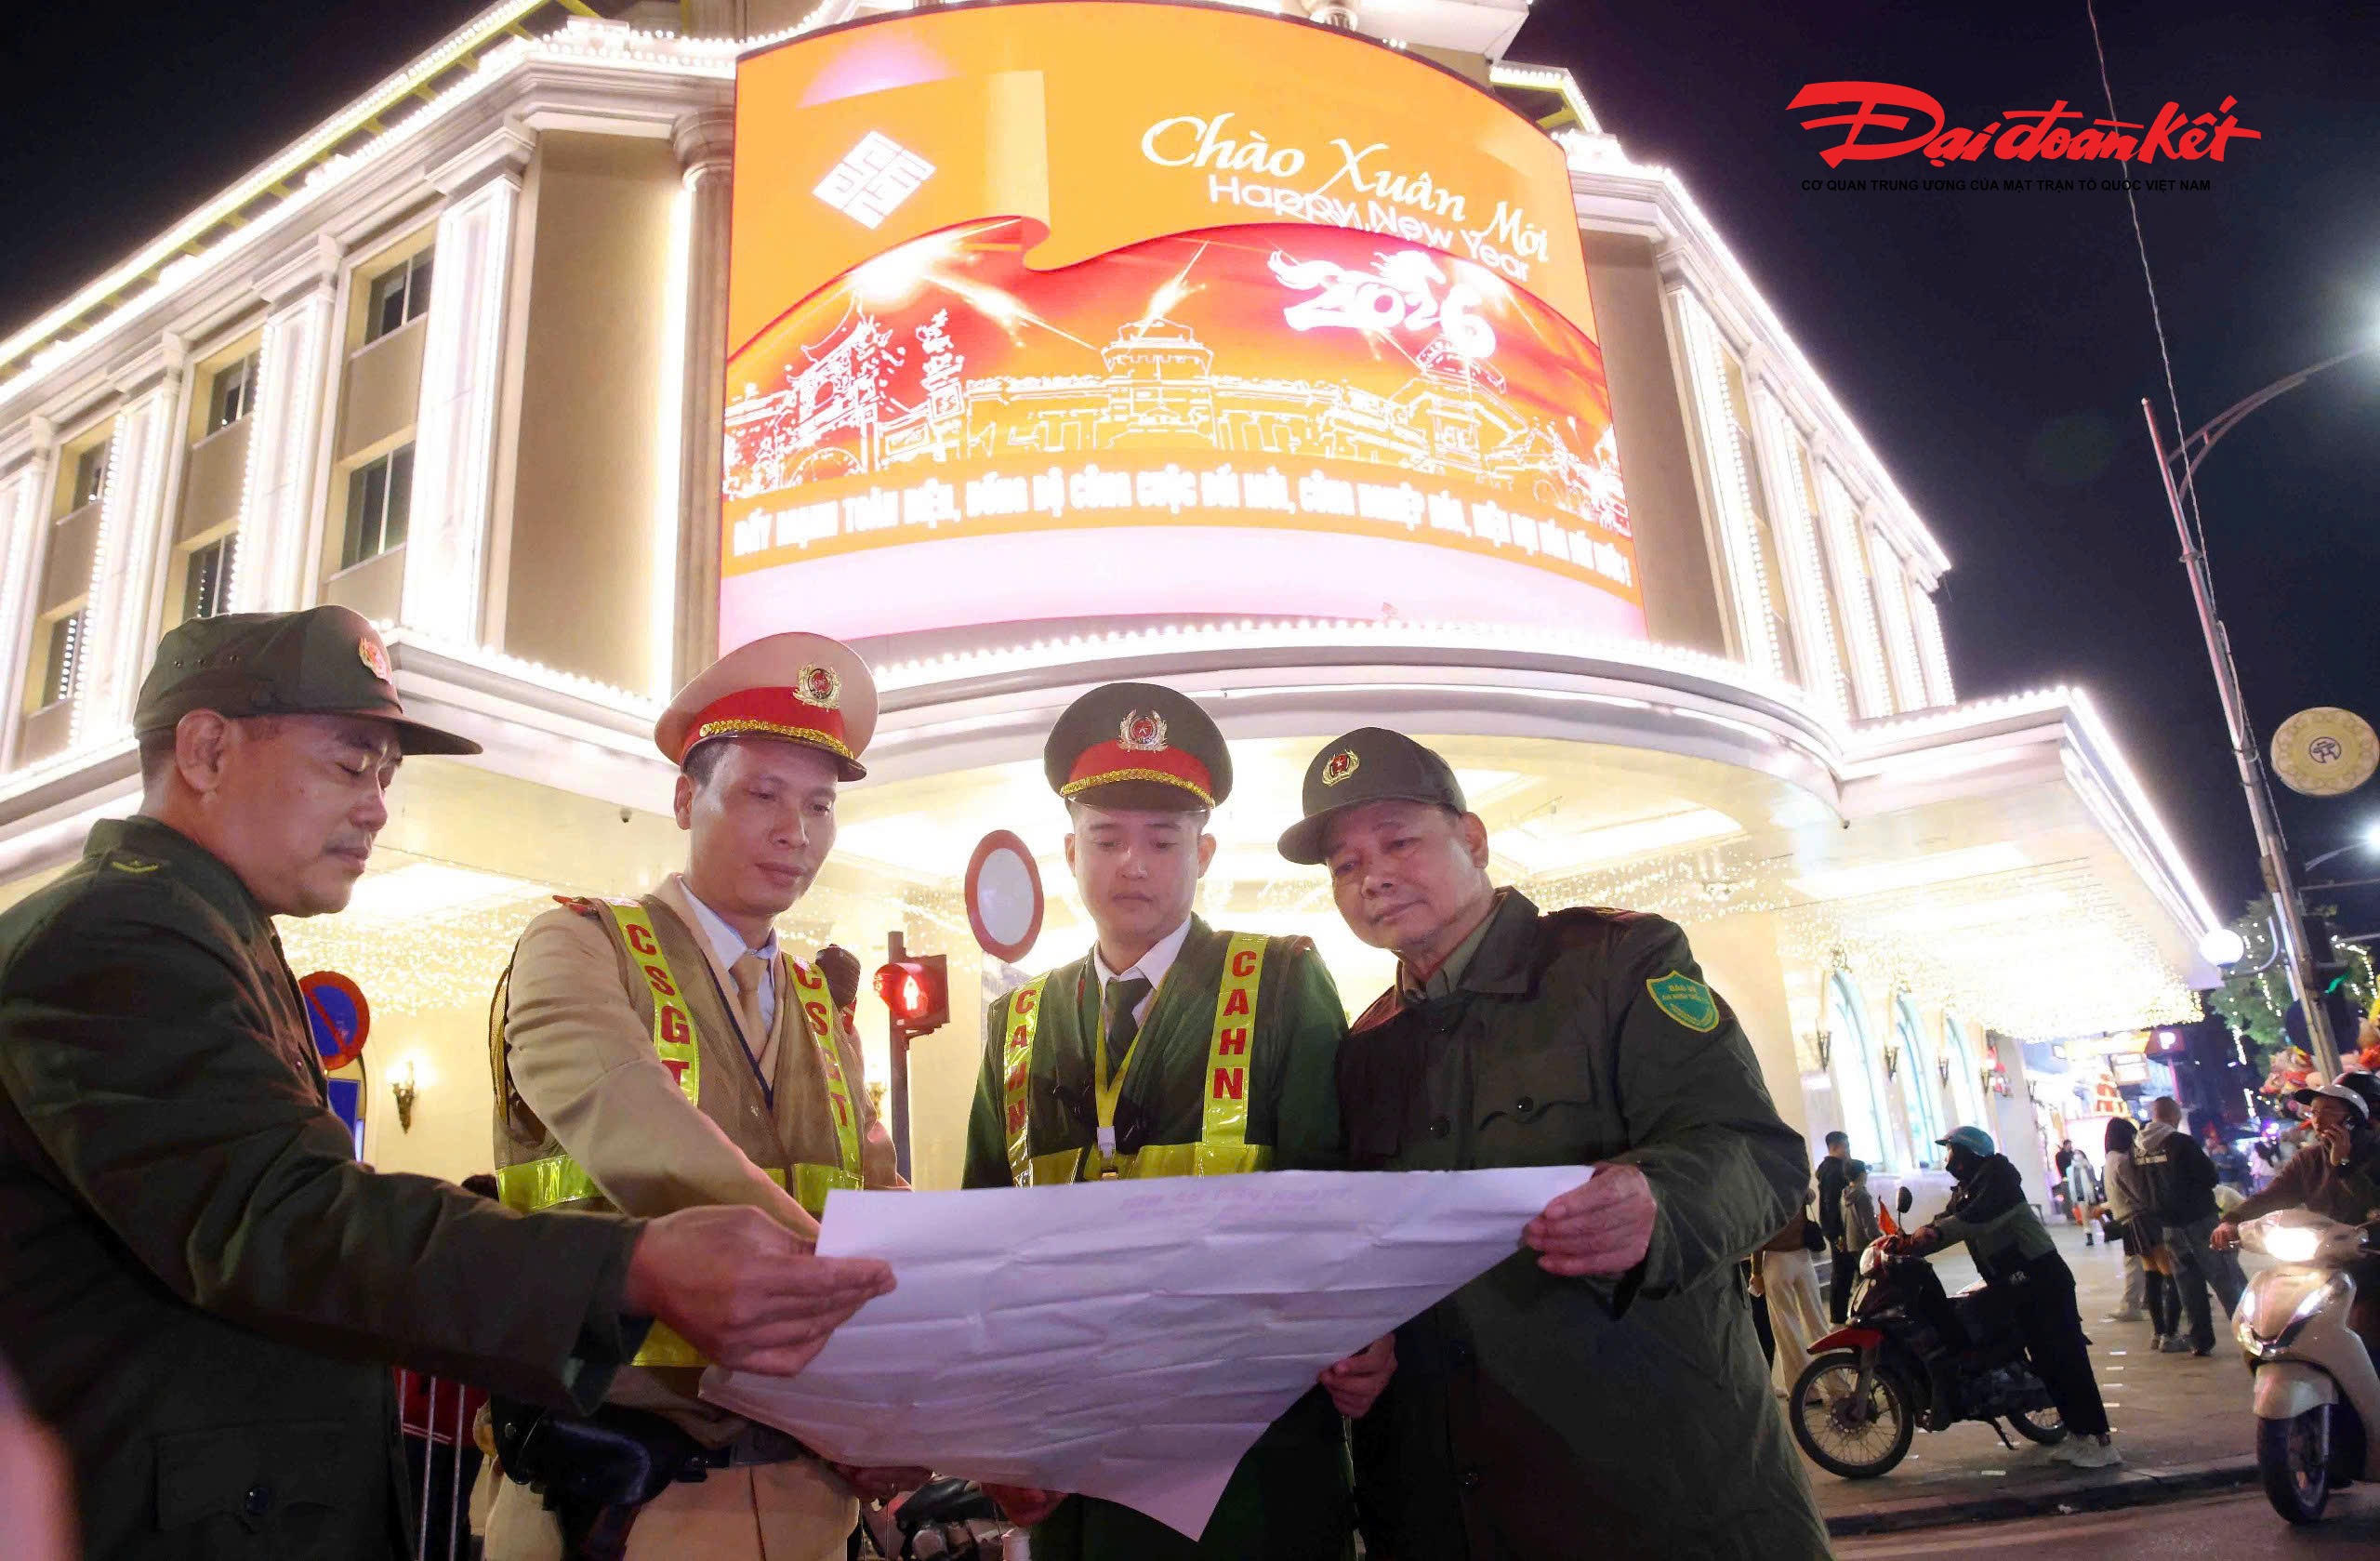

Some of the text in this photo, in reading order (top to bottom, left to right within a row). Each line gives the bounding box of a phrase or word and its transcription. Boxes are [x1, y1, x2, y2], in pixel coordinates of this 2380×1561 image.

[1141, 112, 1550, 263] Chào Xuân Mới
[1368, 199, 1454, 249] New
[1461, 228, 1529, 283] Year
[1281, 264, 1497, 359] 2026
[625, 923, 691, 1086] CSGT
[1212, 950, 1257, 1100] CAHN
